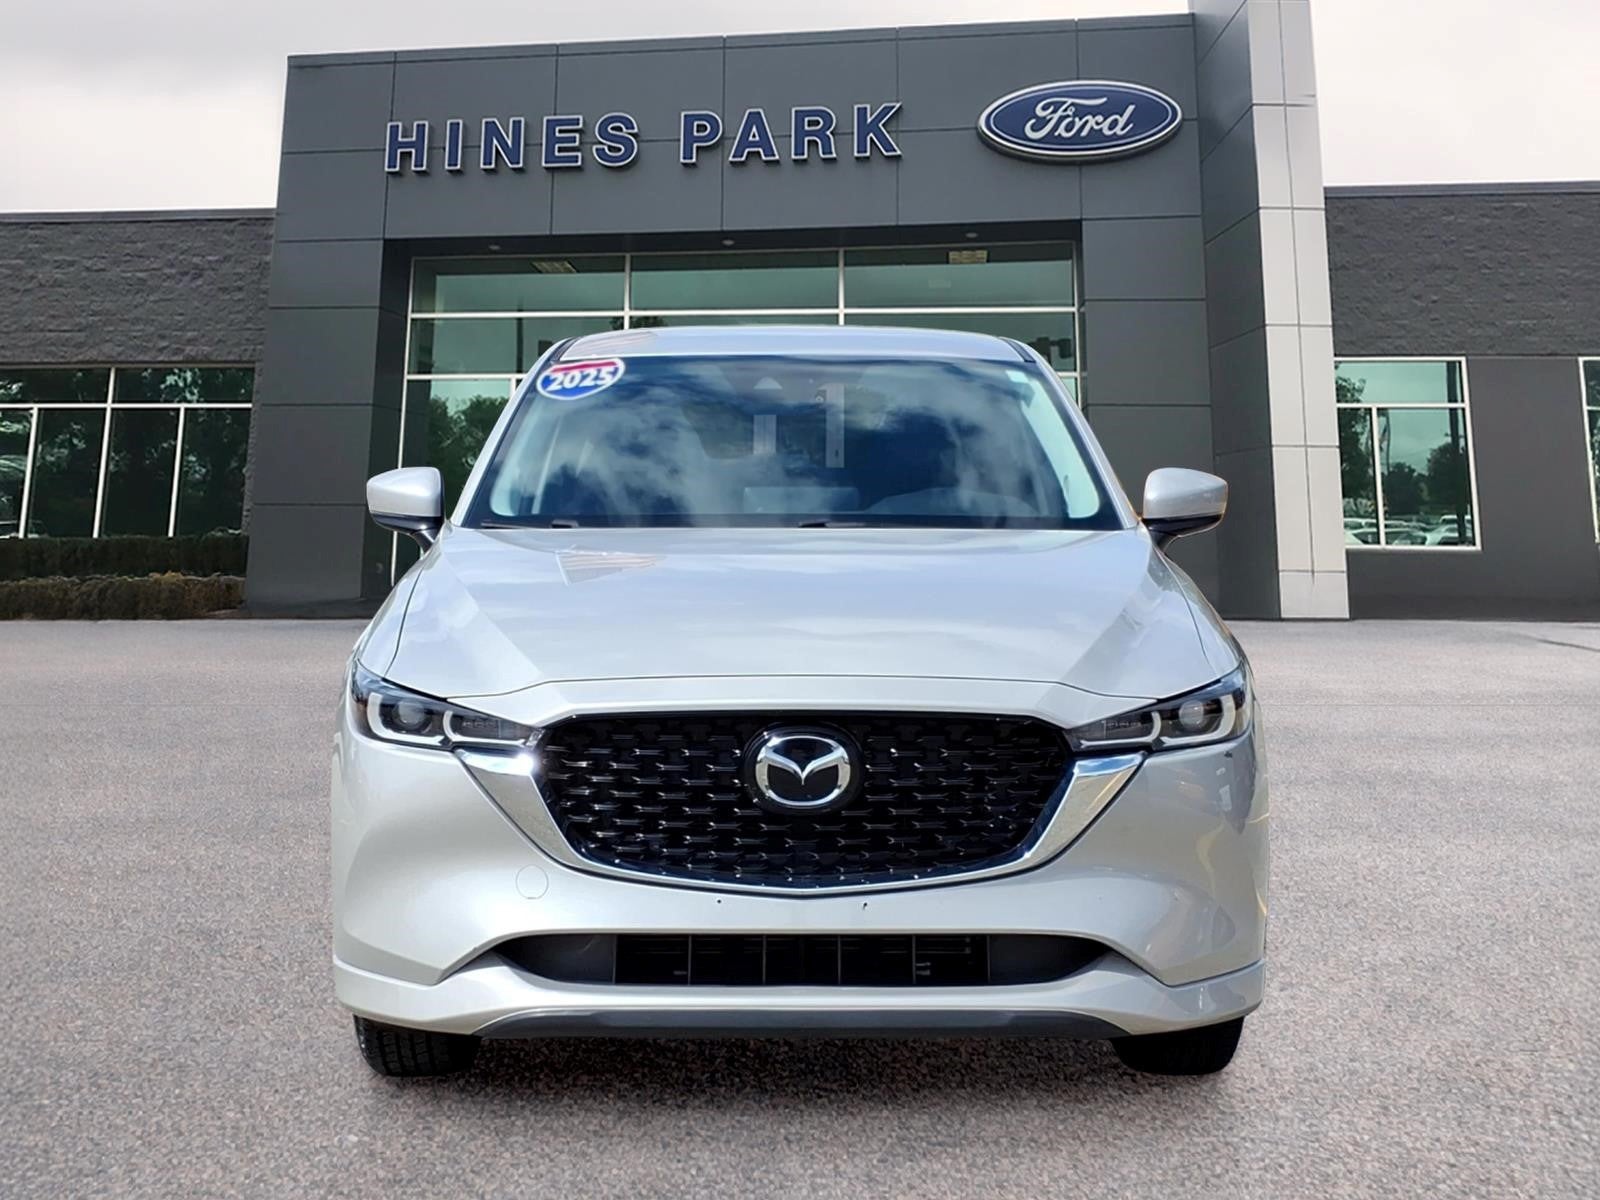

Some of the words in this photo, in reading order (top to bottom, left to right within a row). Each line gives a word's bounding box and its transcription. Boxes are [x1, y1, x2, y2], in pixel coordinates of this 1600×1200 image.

[384, 113, 639, 172] HINES
[679, 103, 902, 163] PARK
[1024, 97, 1136, 139] Ford
[546, 367, 616, 391] 2025
